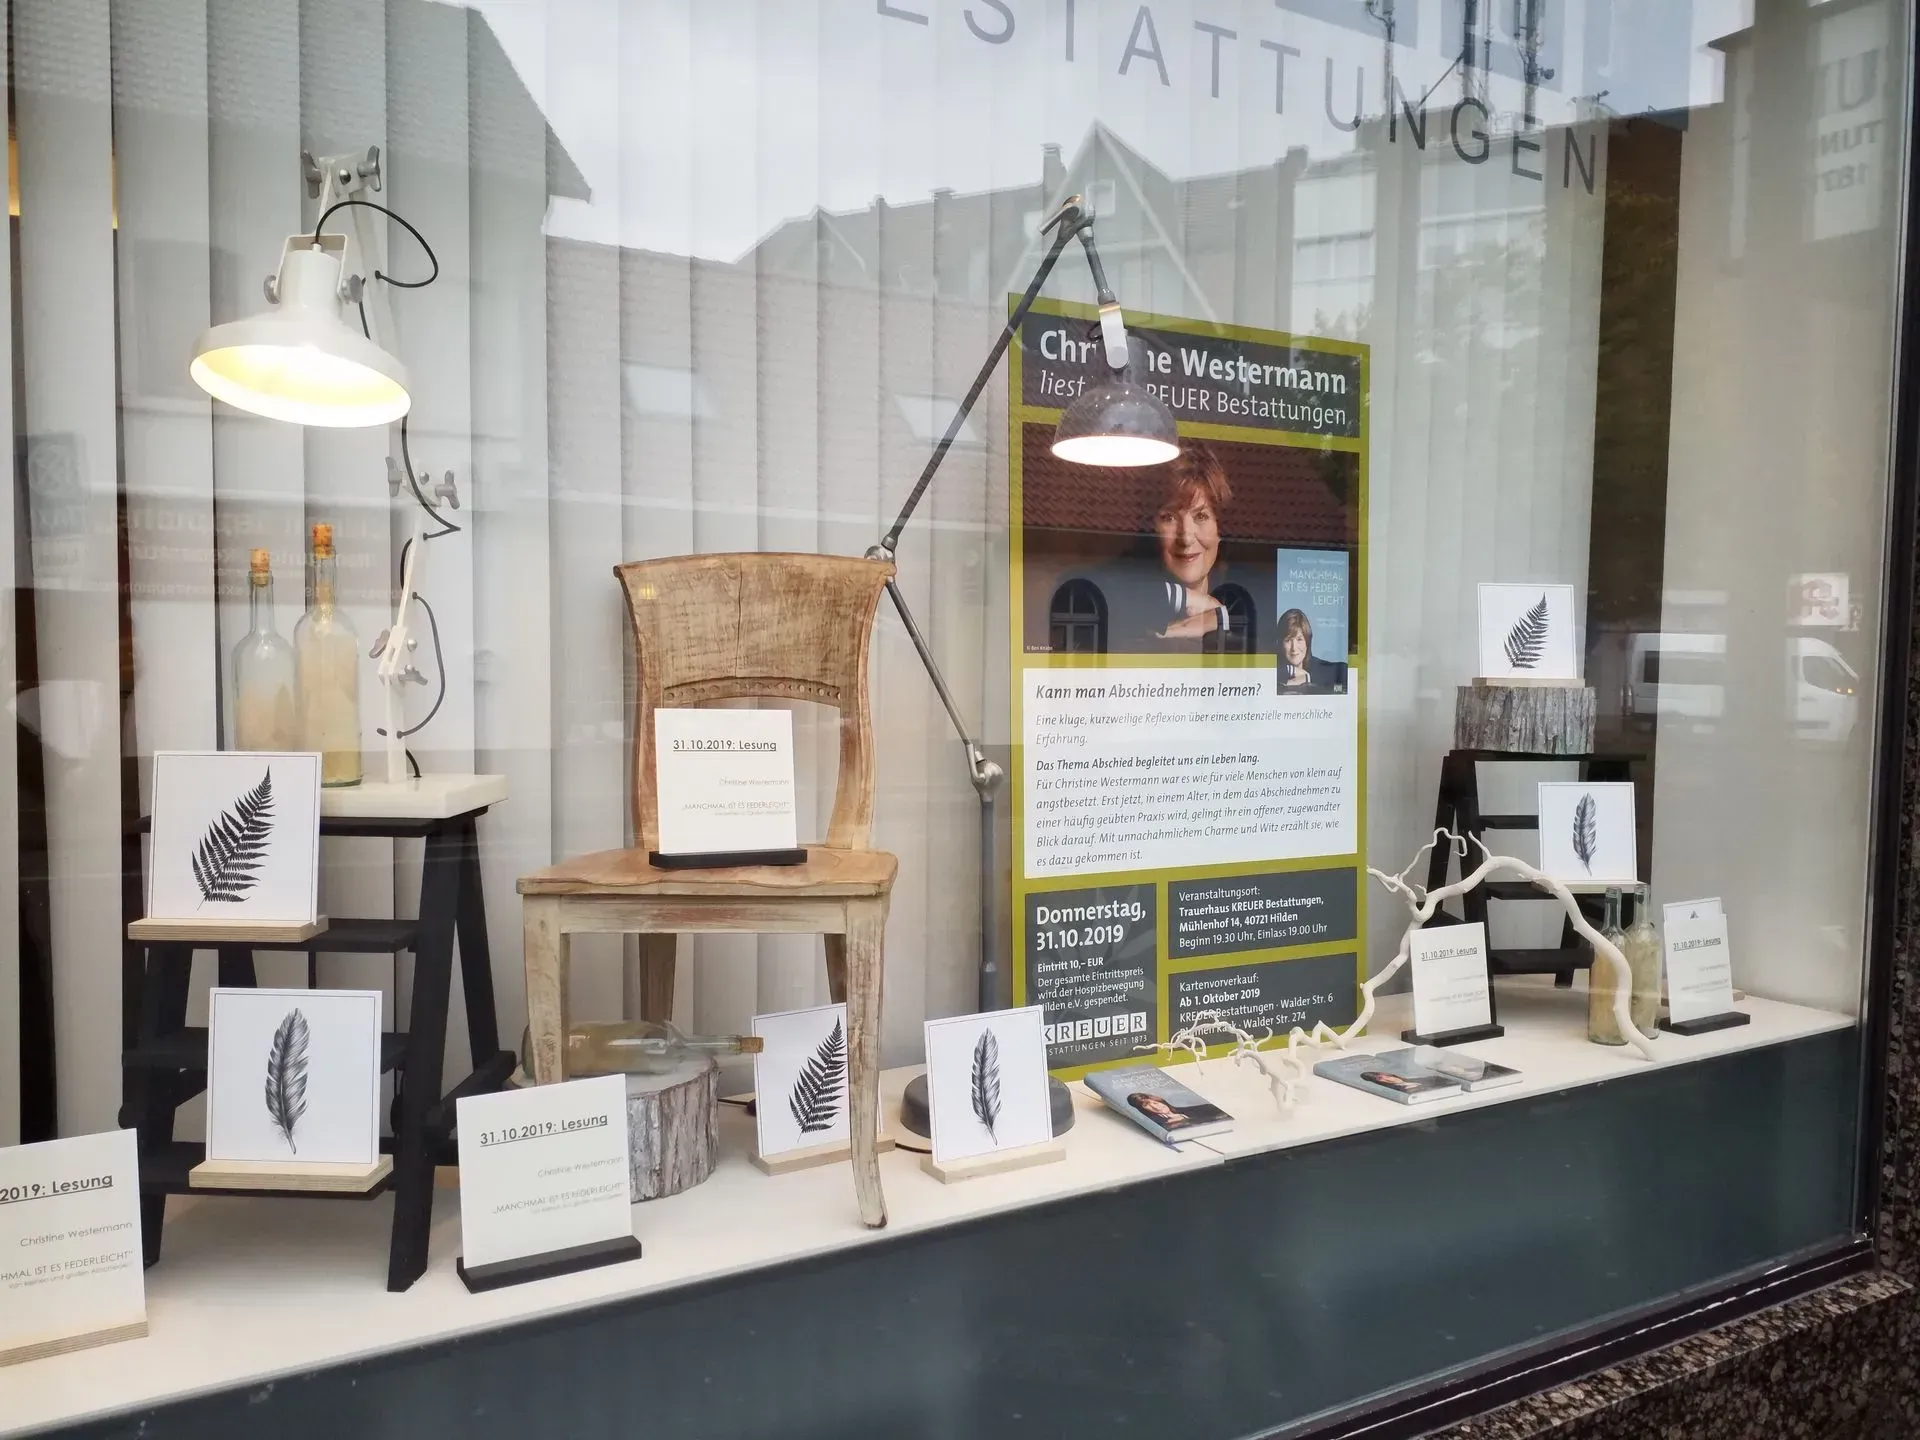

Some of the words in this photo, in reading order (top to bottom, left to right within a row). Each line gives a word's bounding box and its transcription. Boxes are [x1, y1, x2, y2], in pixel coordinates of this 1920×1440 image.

[1180, 347, 1346, 395] Westermann
[1040, 370, 1086, 397] liest
[1147, 383, 1210, 412] REUER
[1217, 391, 1346, 429] Bestattungen
[1312, 596, 1344, 606] LEICHT
[1036, 685, 1071, 699] Kann
[1076, 686, 1106, 698] man
[1109, 683, 1214, 698] Abschiednehmen
[1218, 683, 1262, 697] lernen?
[1036, 714, 1056, 726] Eine
[1059, 714, 1088, 728] kluge,
[1090, 712, 1144, 727] kurzweilige
[1146, 712, 1186, 726] Reflexion
[1189, 712, 1209, 722] über
[1211, 712, 1229, 722] eine
[1230, 710, 1282, 721] existenzielle
[1284, 709, 1334, 720] menschliche
[673, 740, 736, 751] 31.10.2019:
[739, 740, 777, 752] Lesung
[1036, 733, 1088, 748] Erfahrung.
[1036, 760, 1054, 771] Das
[1057, 759, 1089, 770] Thema
[1092, 757, 1133, 768] Abschied
[1136, 756, 1175, 770] begleitet
[1178, 757, 1194, 766] uns
[1196, 755, 1209, 765] ein
[1212, 754, 1236, 765] Leben
[1238, 753, 1260, 766] lang.
[1036, 779, 1052, 790] Für
[1055, 778, 1098, 789] Christine
[1100, 776, 1160, 788] Westermann
[1162, 776, 1179, 785] war
[1182, 775, 1190, 784] es
[1192, 772, 1208, 783] wie
[1208, 772, 1223, 786] für
[1225, 770, 1244, 782] viele
[1246, 768, 1288, 780] Menschen
[1290, 770, 1304, 778] von
[1307, 767, 1326, 778] klein
[1328, 766, 1342, 780] auf
[1036, 796, 1100, 812] angstbesetzt.
[1102, 795, 1118, 806] Erst
[1120, 794, 1144, 808] jetzt,
[1146, 794, 1155, 804] in
[1157, 792, 1184, 803] einem
[1212, 790, 1221, 800] in
[1223, 788, 1242, 800] dem
[1244, 787, 1258, 798] das
[1260, 785, 1330, 798] Abschiednehmen
[1331, 785, 1341, 794] zu
[1036, 817, 1062, 828] einer
[1064, 814, 1094, 830] häufig
[1096, 813, 1136, 828] geübten
[1138, 811, 1165, 822] Praxis
[1167, 810, 1190, 822] wird,
[1192, 807, 1222, 822] gelingt
[1224, 806, 1237, 818] ihr
[1238, 806, 1252, 816] ein
[1254, 804, 1285, 818] offener,
[1288, 802, 1341, 816] zugewandter
[1036, 835, 1059, 848] Blick
[1061, 833, 1097, 848] darauf.
[1099, 832, 1116, 844] Mit
[1118, 828, 1202, 842] unnachahmlichem
[1204, 825, 1238, 837] Charme
[1240, 823, 1258, 834] und
[1260, 822, 1279, 832] Witz
[1280, 820, 1309, 832] erzählt
[1311, 820, 1323, 830] sie,
[1326, 819, 1340, 828] wie
[1036, 858, 1046, 867] es
[1049, 854, 1073, 866] dazu
[1075, 852, 1128, 867] gekommen
[1130, 850, 1143, 860] ist.
[1179, 886, 1260, 902] Veranstaltungsort:
[1036, 900, 1146, 925] Donnerstag,
[1179, 904, 1230, 917] Trauerhaus
[1232, 900, 1264, 912] KREUER
[1266, 895, 1324, 908] Bestattungen,
[1179, 918, 1229, 933] Mühlenhof
[1231, 917, 1242, 928] 14,
[1244, 914, 1268, 926] 40721
[1270, 912, 1298, 924] Hilden
[1036, 924, 1124, 951] 31.10.2019
[1180, 935, 1210, 950] Beginn
[1213, 932, 1236, 945] 19.30
[1238, 930, 1256, 942] Uhr,
[1258, 928, 1286, 940] Einlass
[1288, 925, 1310, 936] 19.00
[1312, 923, 1328, 934] Uhr
[1038, 961, 1068, 973] Eintritt
[1088, 957, 1104, 967] EUR
[1038, 978, 1052, 988] Der
[1054, 974, 1090, 988] gesamte
[1092, 966, 1144, 981] Eintrittspreis
[1180, 973, 1260, 993] Kartenvorverkauf:
[1038, 990, 1058, 1000] wird
[1059, 987, 1072, 997] der
[1074, 980, 1144, 996] Hospizbewegung
[1180, 997, 1192, 1008] Ab
[1194, 996, 1201, 1006] 1.
[1202, 991, 1239, 1005] Oktober
[1240, 988, 1260, 1000] 2019
[1068, 999, 1082, 1009] e.V.
[1084, 993, 1128, 1010] gespendet.
[1216, 1002, 1274, 1018] Bestattungen
[1280, 997, 1310, 1009] Walder
[1312, 995, 1326, 1005] Str.
[1328, 993, 1334, 1002] 6
[1243, 1014, 1274, 1029] Walder
[1276, 1013, 1290, 1025] Str.
[1292, 1011, 1306, 1022] 274
[1110, 1037, 1127, 1047] SEIT
[1132, 1034, 1148, 1044] 1873
[480, 1121, 558, 1146] 31.10.2019:
[562, 1114, 608, 1132] Lesung
[0, 1183, 46, 1201] 2019:
[52, 1174, 114, 1194] Lesung
[20, 1232, 66, 1248] Christine
[68, 1222, 132, 1238] Westermann
[0, 1268, 32, 1281] HMAL
[34, 1265, 48, 1276] IST
[50, 1263, 62, 1273] ES
